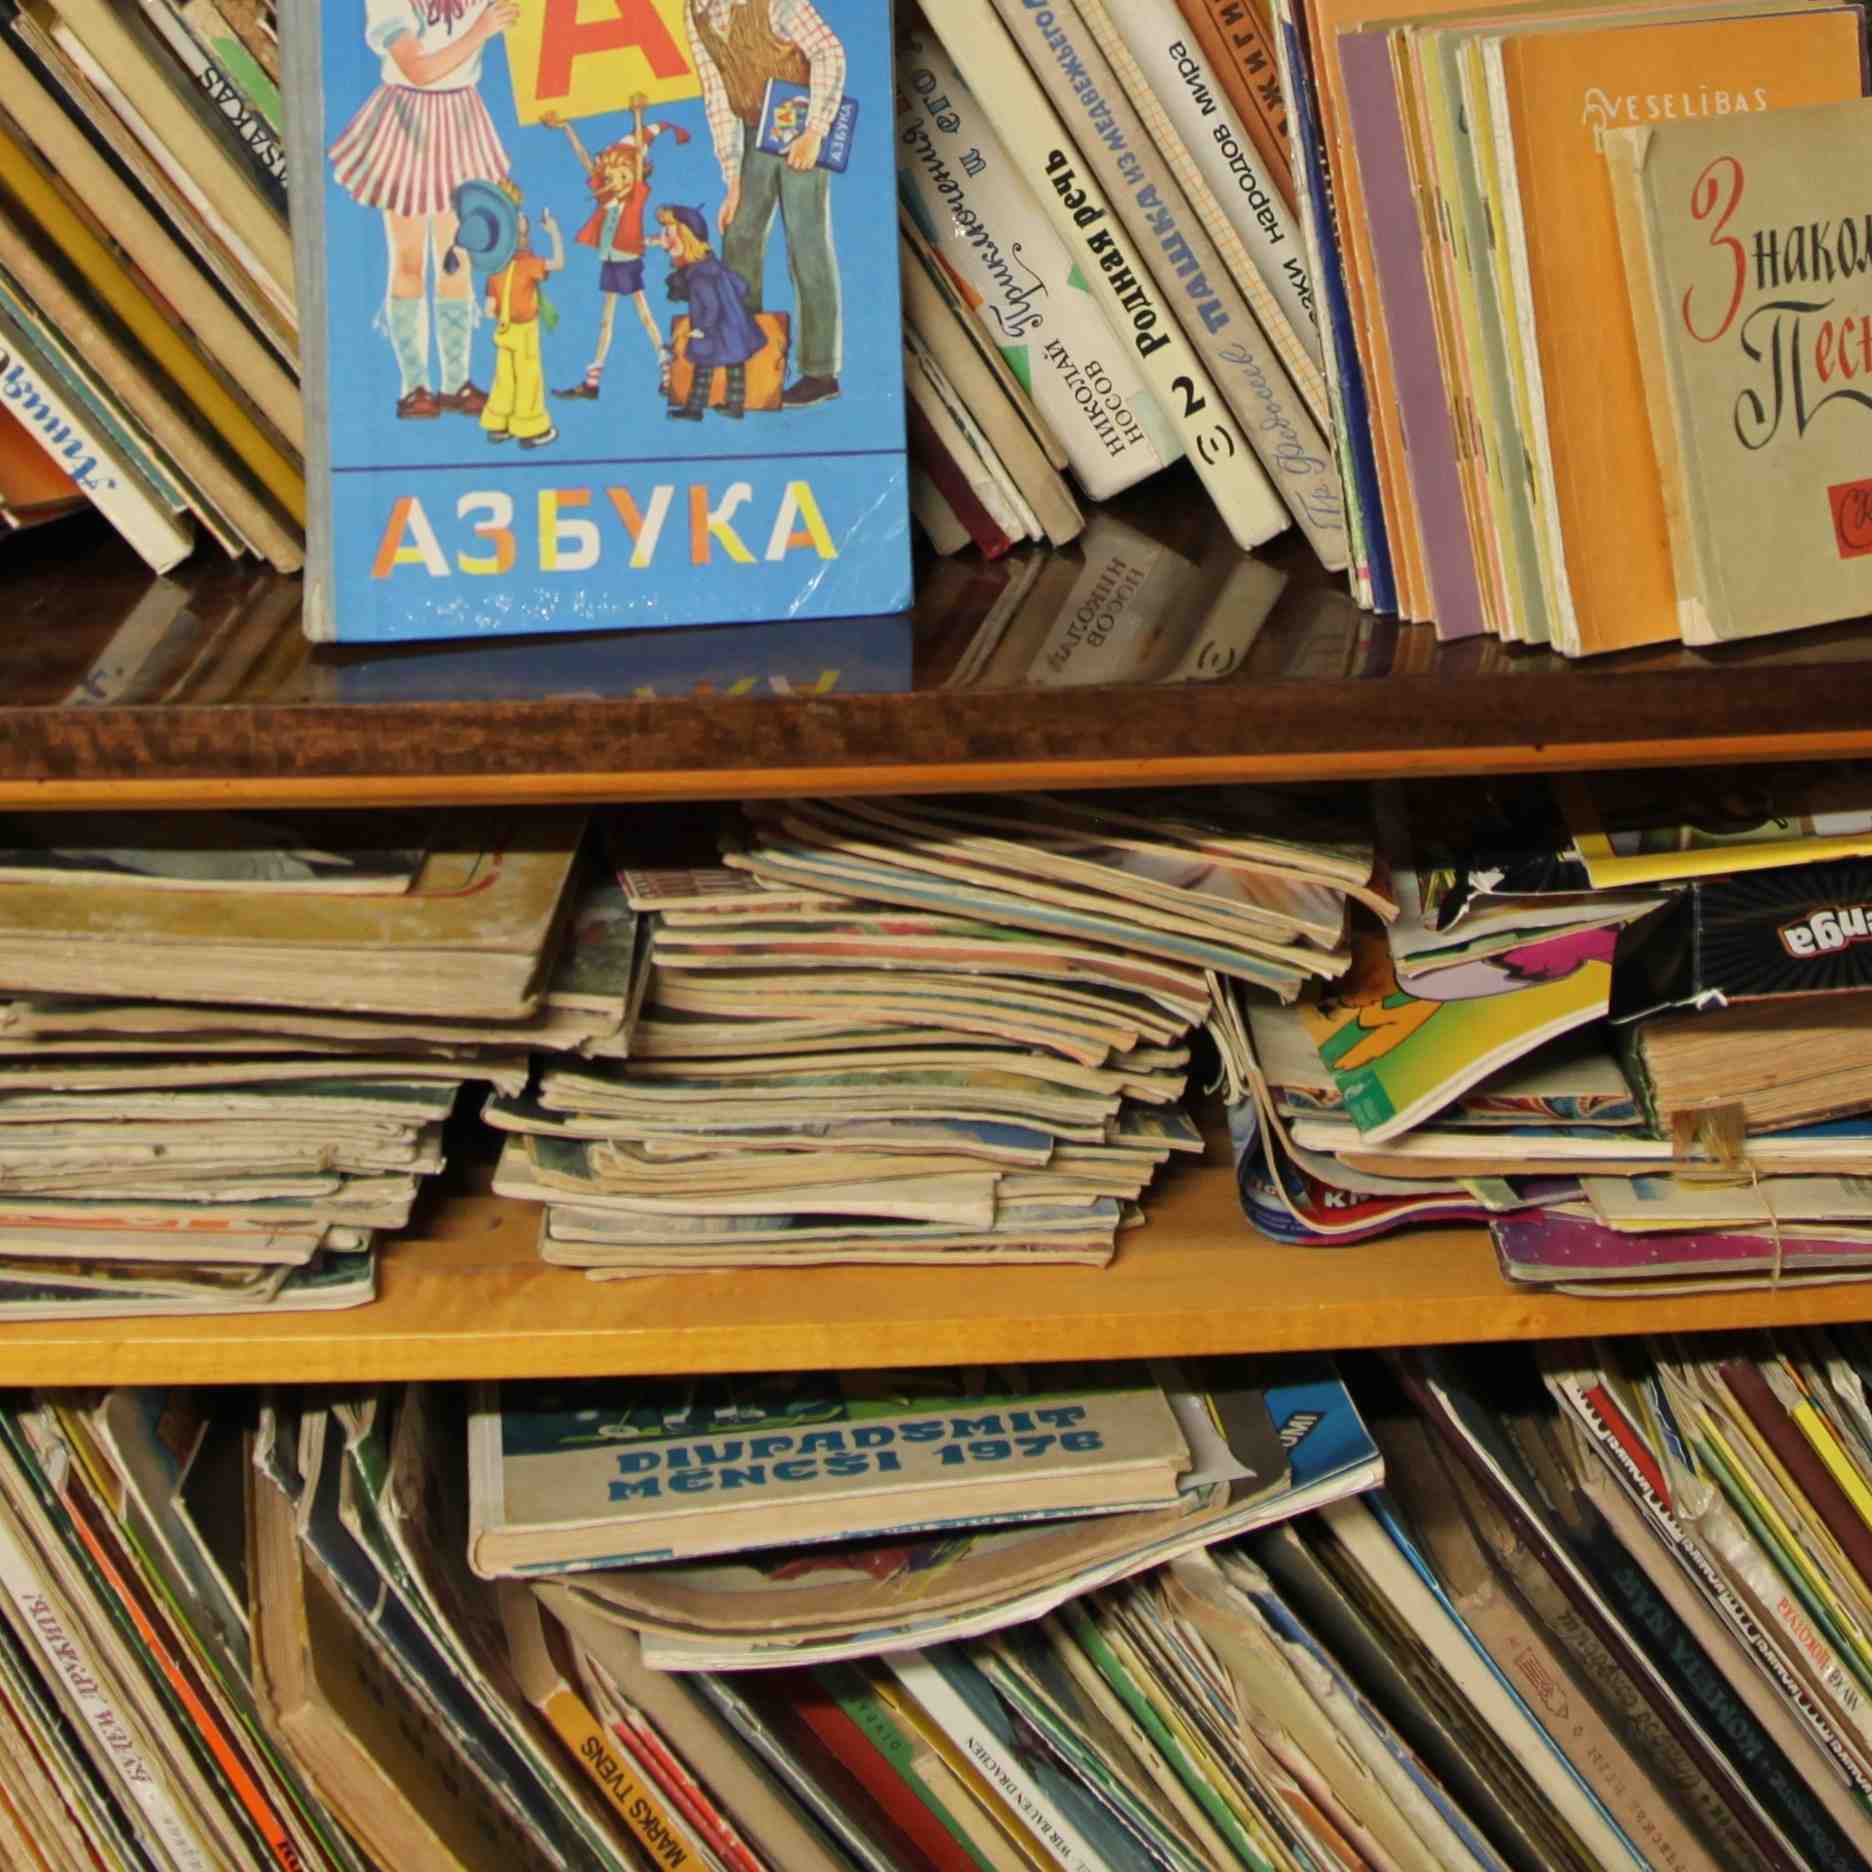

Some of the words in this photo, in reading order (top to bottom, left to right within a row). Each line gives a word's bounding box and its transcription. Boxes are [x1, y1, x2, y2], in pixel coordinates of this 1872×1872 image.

[1035, 10, 1128, 152] МЕДВЕЖЬЕГО
[1161, 39, 1220, 118] мира
[828, 101, 855, 163] АЗБУКА
[1116, 145, 1147, 183] ИЗ
[1043, 149, 1105, 230] речь
[1204, 121, 1290, 246] народов
[900, 113, 1054, 343] Приключения
[1135, 183, 1231, 336] ПАШКА
[1086, 227, 1171, 360] Родная
[1042, 335, 1126, 460] НИКОЛАЙ
[1080, 359, 1145, 445] НОСОВ
[1171, 375, 1207, 419] 2
[370, 481, 838, 580] АЗБУКА
[616, 1405, 1086, 1475] DIVPADSMIT
[933, 1430, 1105, 1466] 1976
[579, 1734, 633, 1801] TVENS
[626, 1800, 688, 1869] MARKS
